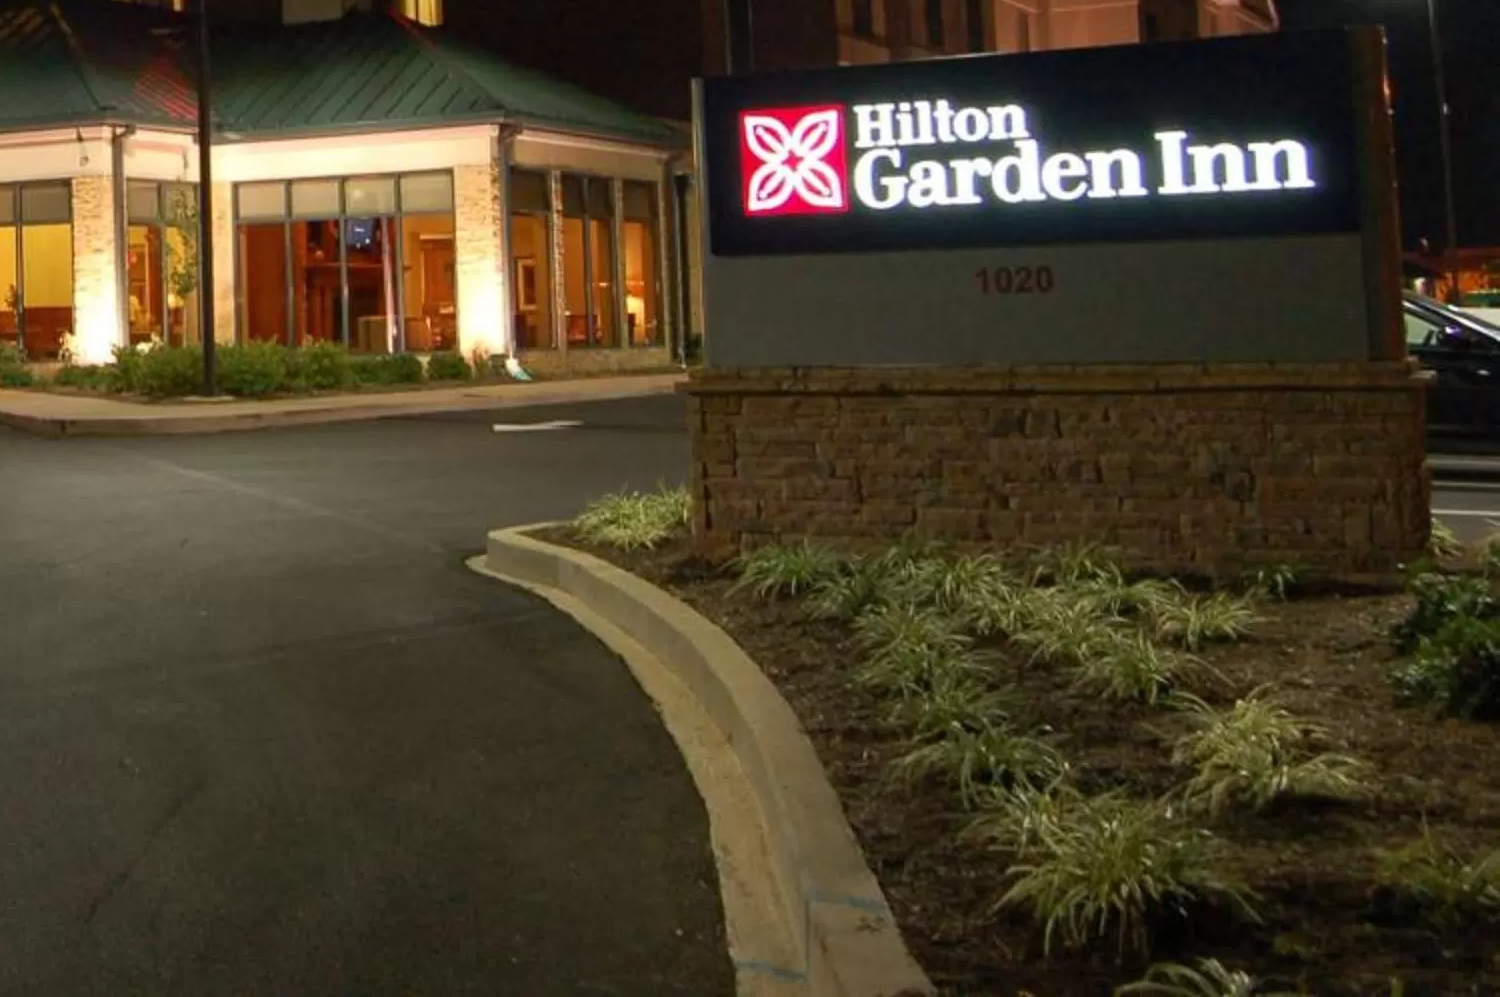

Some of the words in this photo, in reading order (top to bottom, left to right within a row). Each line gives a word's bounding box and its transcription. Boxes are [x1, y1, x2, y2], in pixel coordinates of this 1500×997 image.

[853, 101, 1029, 148] Hilton
[853, 140, 1147, 209] Garden
[1154, 130, 1315, 194] Inn
[975, 265, 1055, 295] 1020
